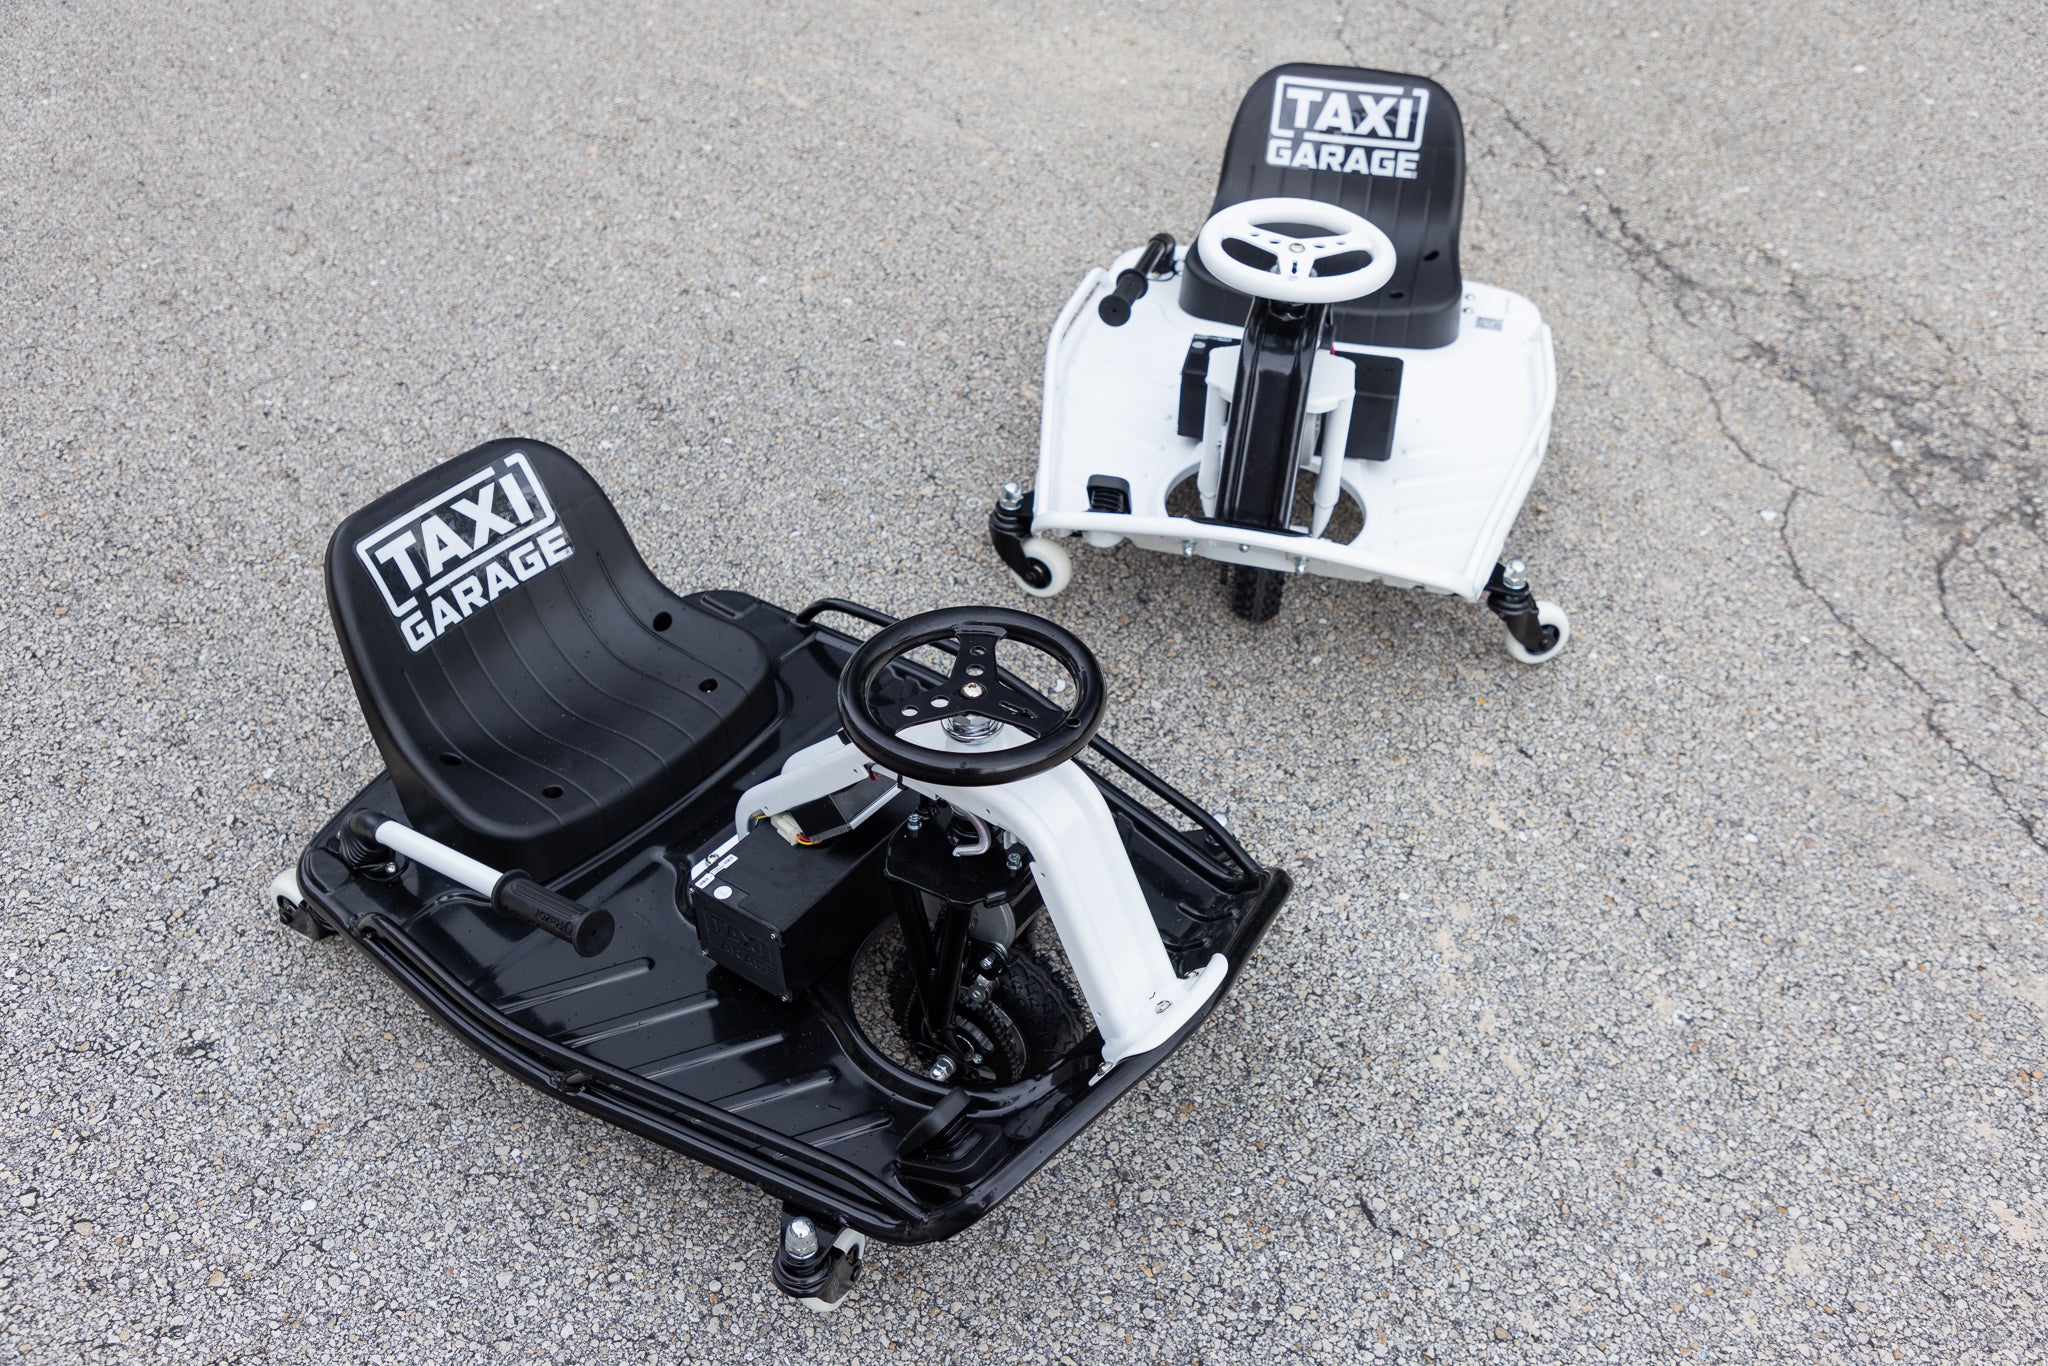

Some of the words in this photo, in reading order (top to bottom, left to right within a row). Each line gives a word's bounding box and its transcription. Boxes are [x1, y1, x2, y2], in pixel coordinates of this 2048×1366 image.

[1286, 86, 1414, 139] TAXI
[1266, 138, 1420, 179] GARAGE
[374, 473, 534, 591] TAXI
[400, 525, 574, 652] GARAGE
[708, 911, 764, 957] TAXI
[708, 933, 776, 977] GARAGE
